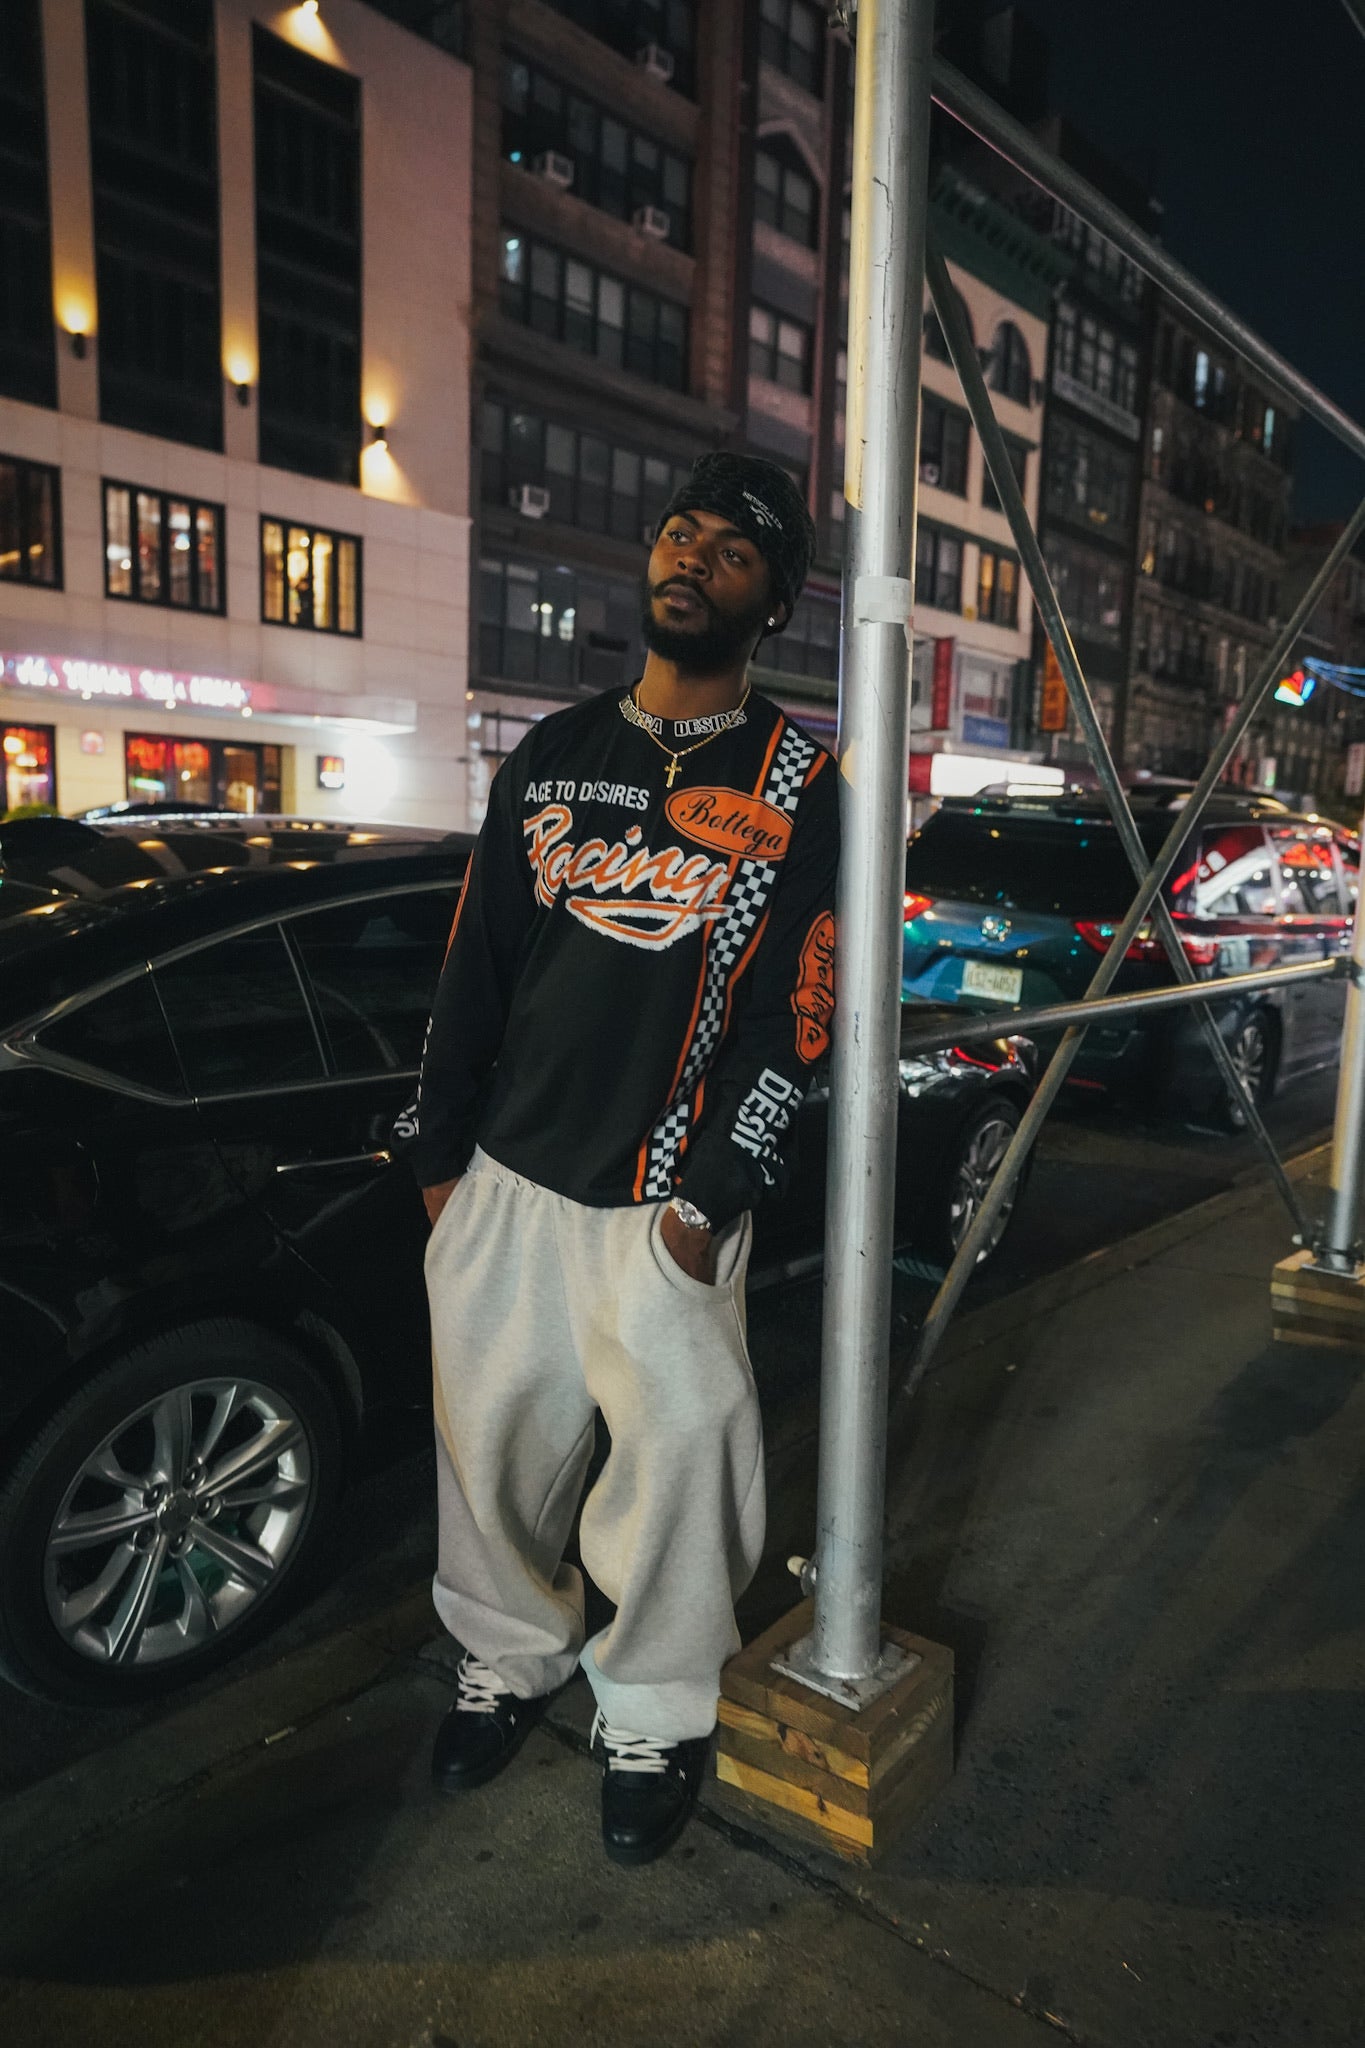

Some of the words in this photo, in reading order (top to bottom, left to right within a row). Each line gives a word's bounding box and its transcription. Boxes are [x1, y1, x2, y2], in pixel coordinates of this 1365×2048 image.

[674, 708, 748, 738] DESIRES
[555, 780, 577, 802] TO
[578, 780, 650, 811] DSIRES
[678, 794, 784, 852] Bottega
[523, 803, 732, 952] Racing
